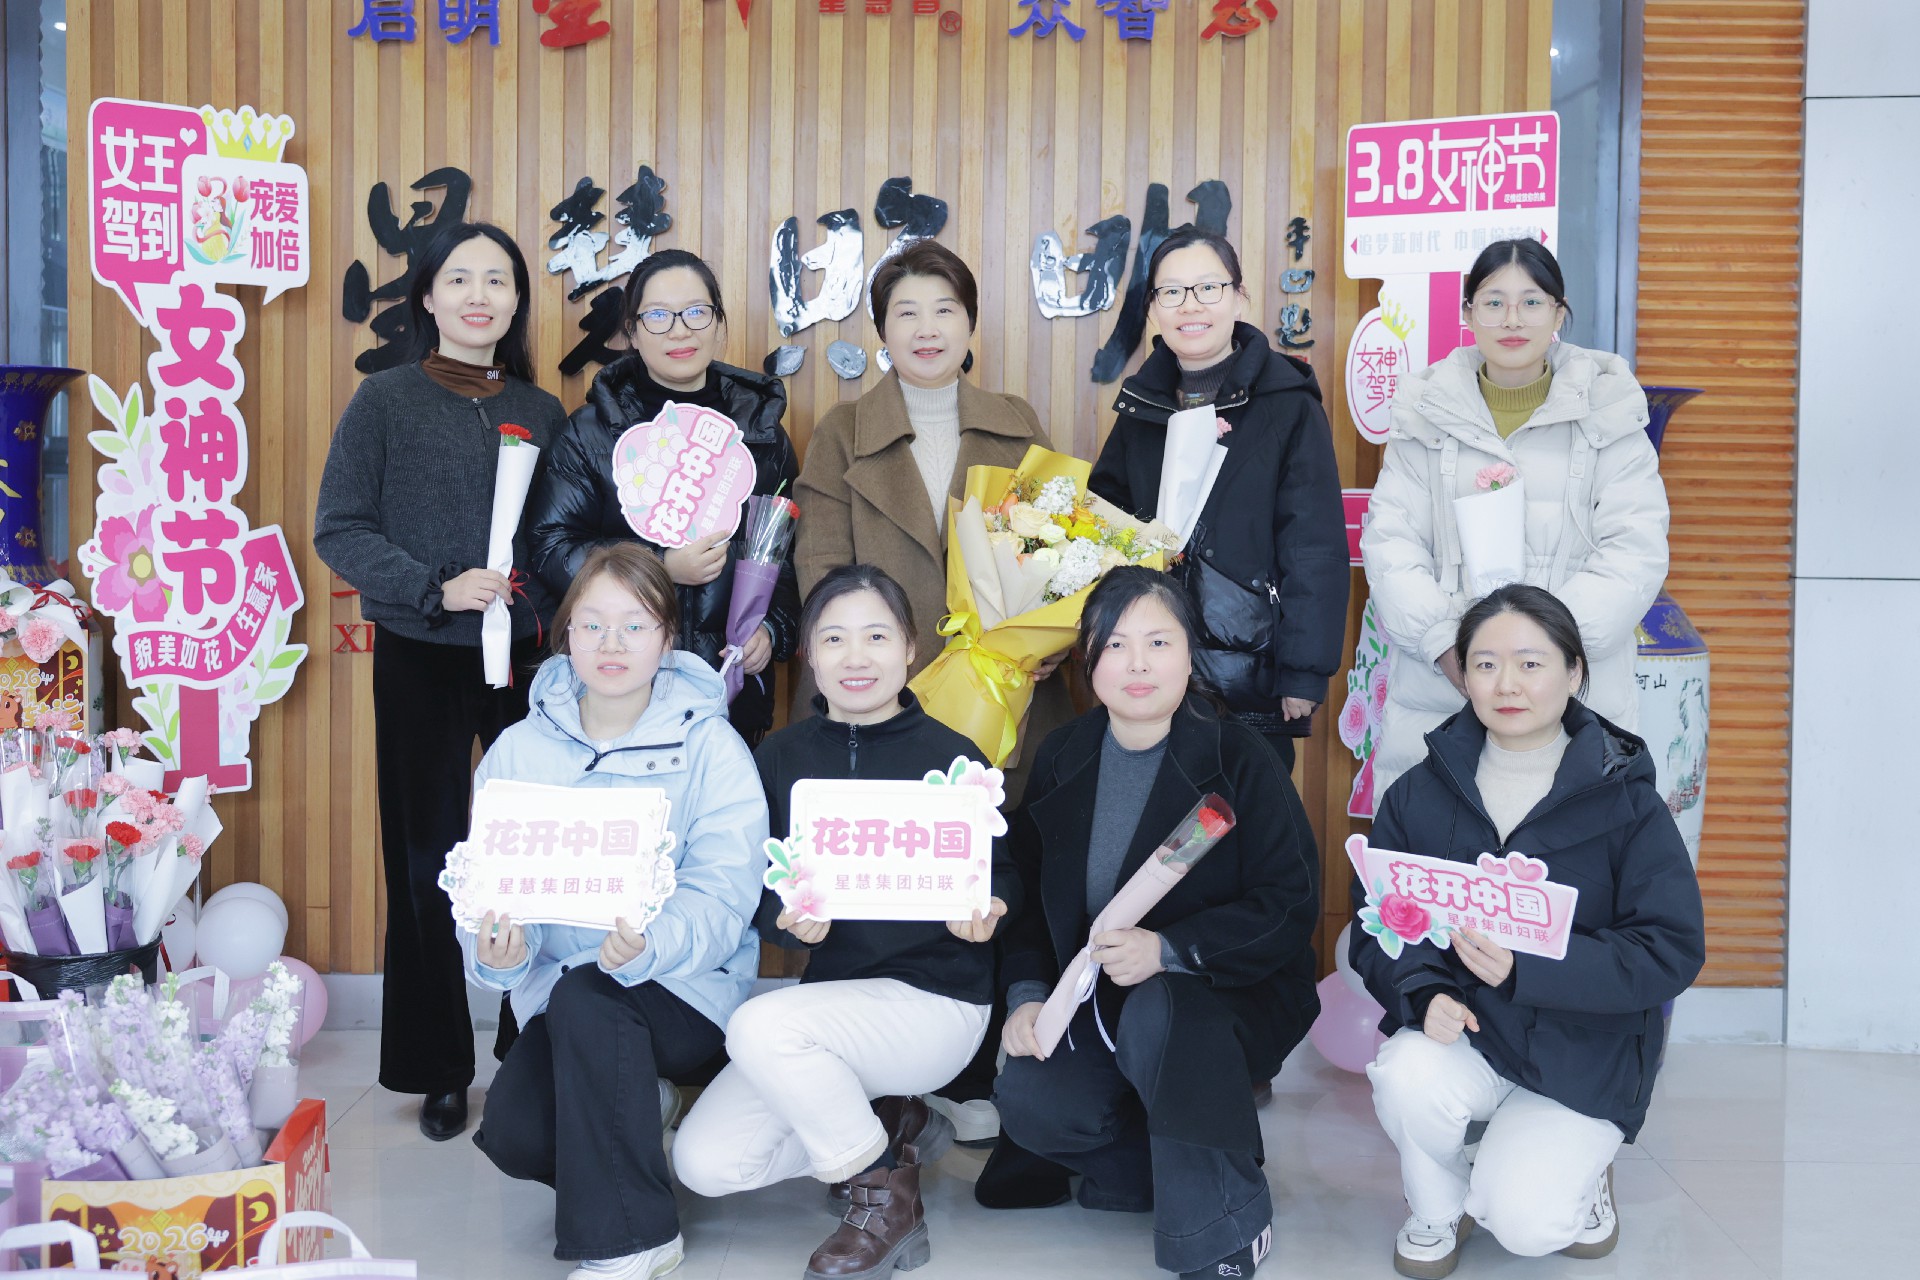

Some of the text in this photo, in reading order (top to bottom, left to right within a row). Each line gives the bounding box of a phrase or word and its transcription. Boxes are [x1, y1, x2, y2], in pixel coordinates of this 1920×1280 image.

[100, 126, 178, 193] 女王
[1354, 121, 1549, 212] 3.8女神节
[250, 178, 299, 225] 宠爱
[102, 197, 178, 265] 驾到
[250, 226, 300, 272] 加倍
[1358, 230, 1441, 257] 追梦新时代
[1356, 343, 1397, 374] 女神
[156, 284, 240, 615] 女神节
[647, 412, 734, 544] 花开中国
[133, 561, 280, 674] 貌美如花人生赢家
[483, 818, 640, 857] 花开中国
[811, 817, 972, 860] 花开中国
[497, 876, 625, 895] 星慧集团妇联
[834, 873, 955, 891] 星慧集团妇联
[1390, 861, 1551, 927] 花开中国
[1446, 912, 1550, 943] 星慧集团妇联
